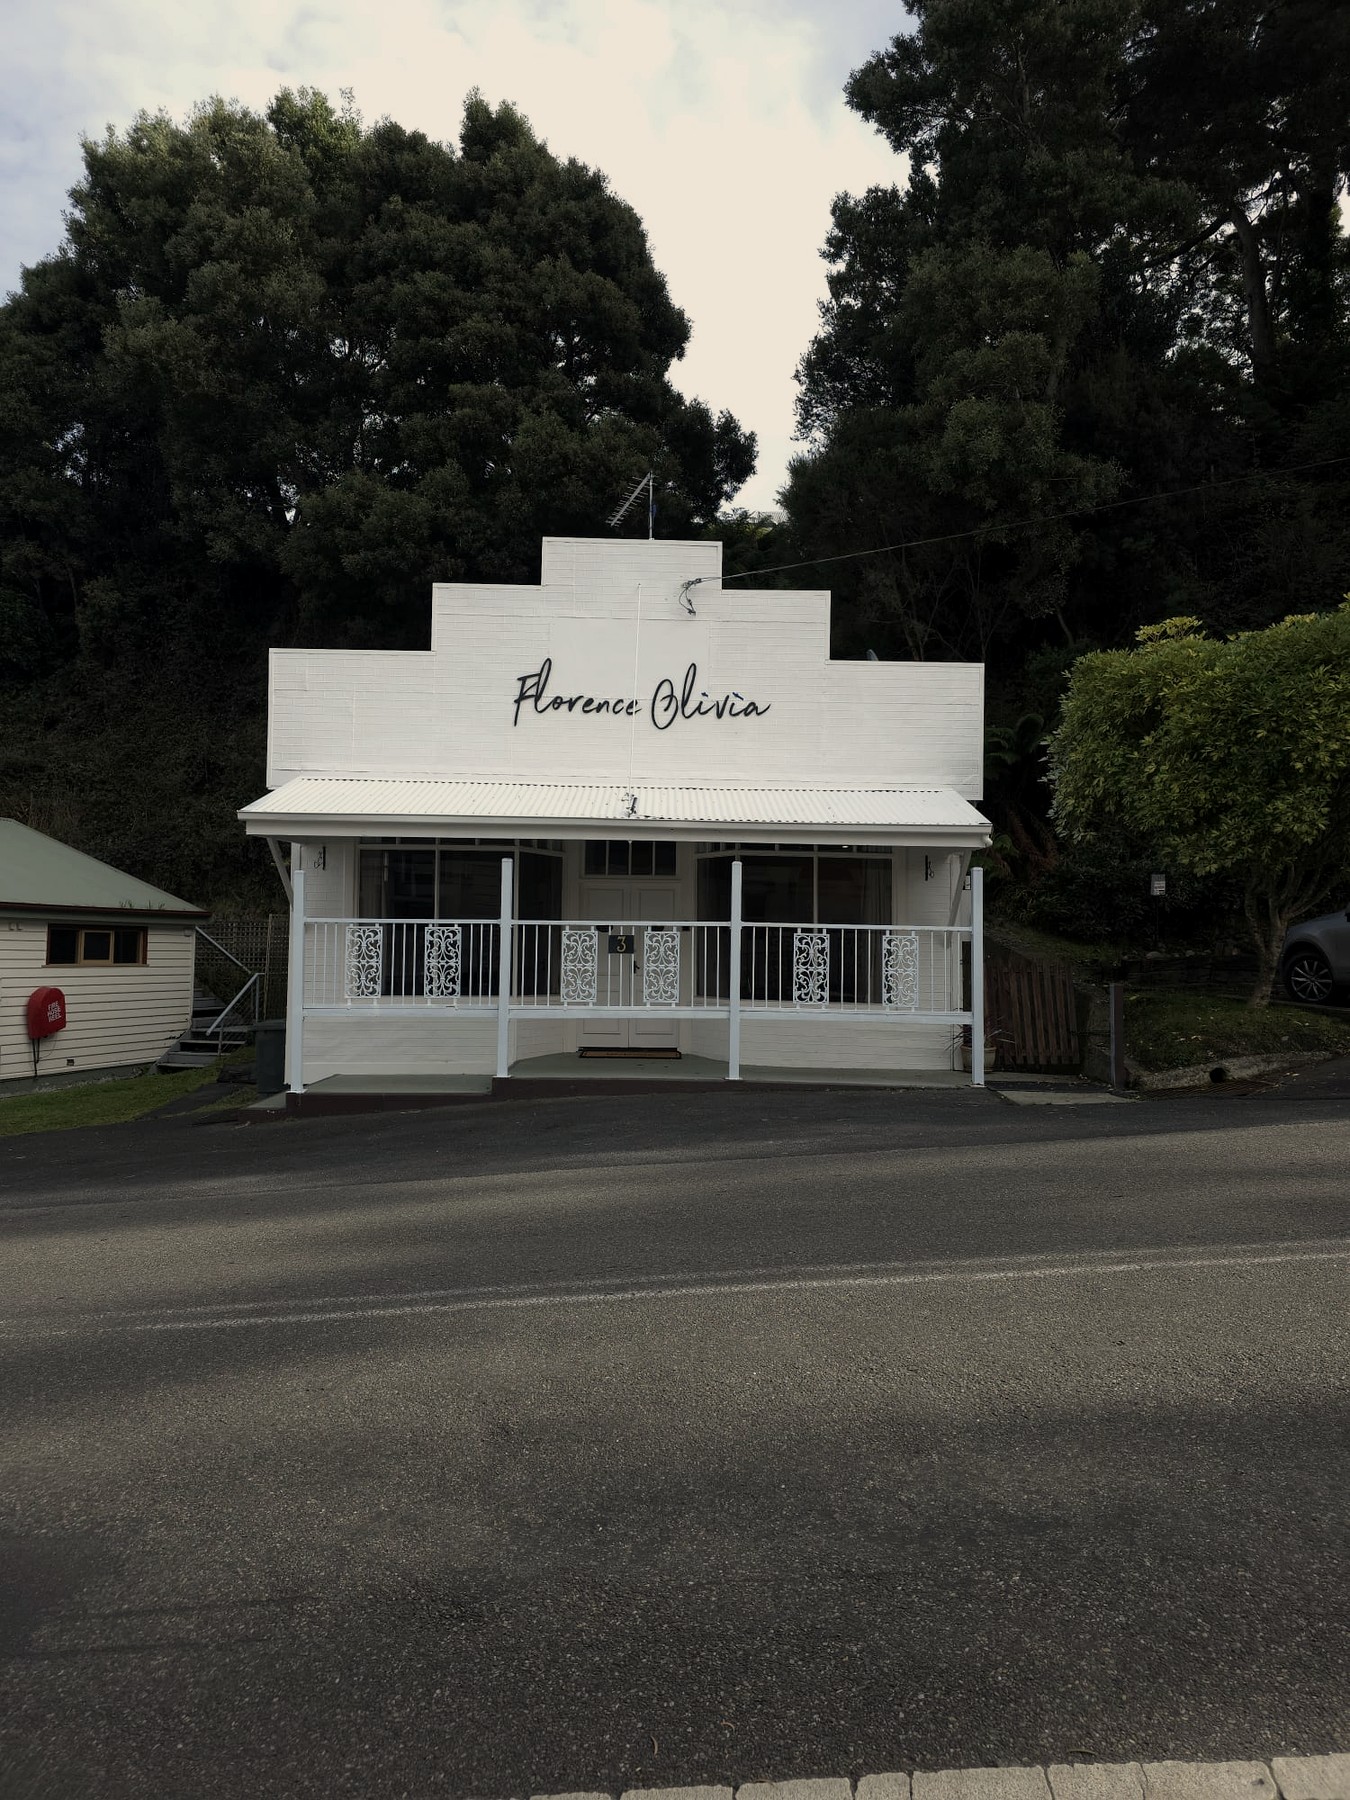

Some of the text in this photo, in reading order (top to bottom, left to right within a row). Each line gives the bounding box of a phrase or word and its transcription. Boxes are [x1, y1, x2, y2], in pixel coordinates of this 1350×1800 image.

[513, 657, 772, 730] Florence Olivia
[616, 936, 626, 952] 3
[48, 1001, 59, 1010] FIRE
[47, 1006, 61, 1017] HOSE
[48, 1012, 61, 1022] REEL
